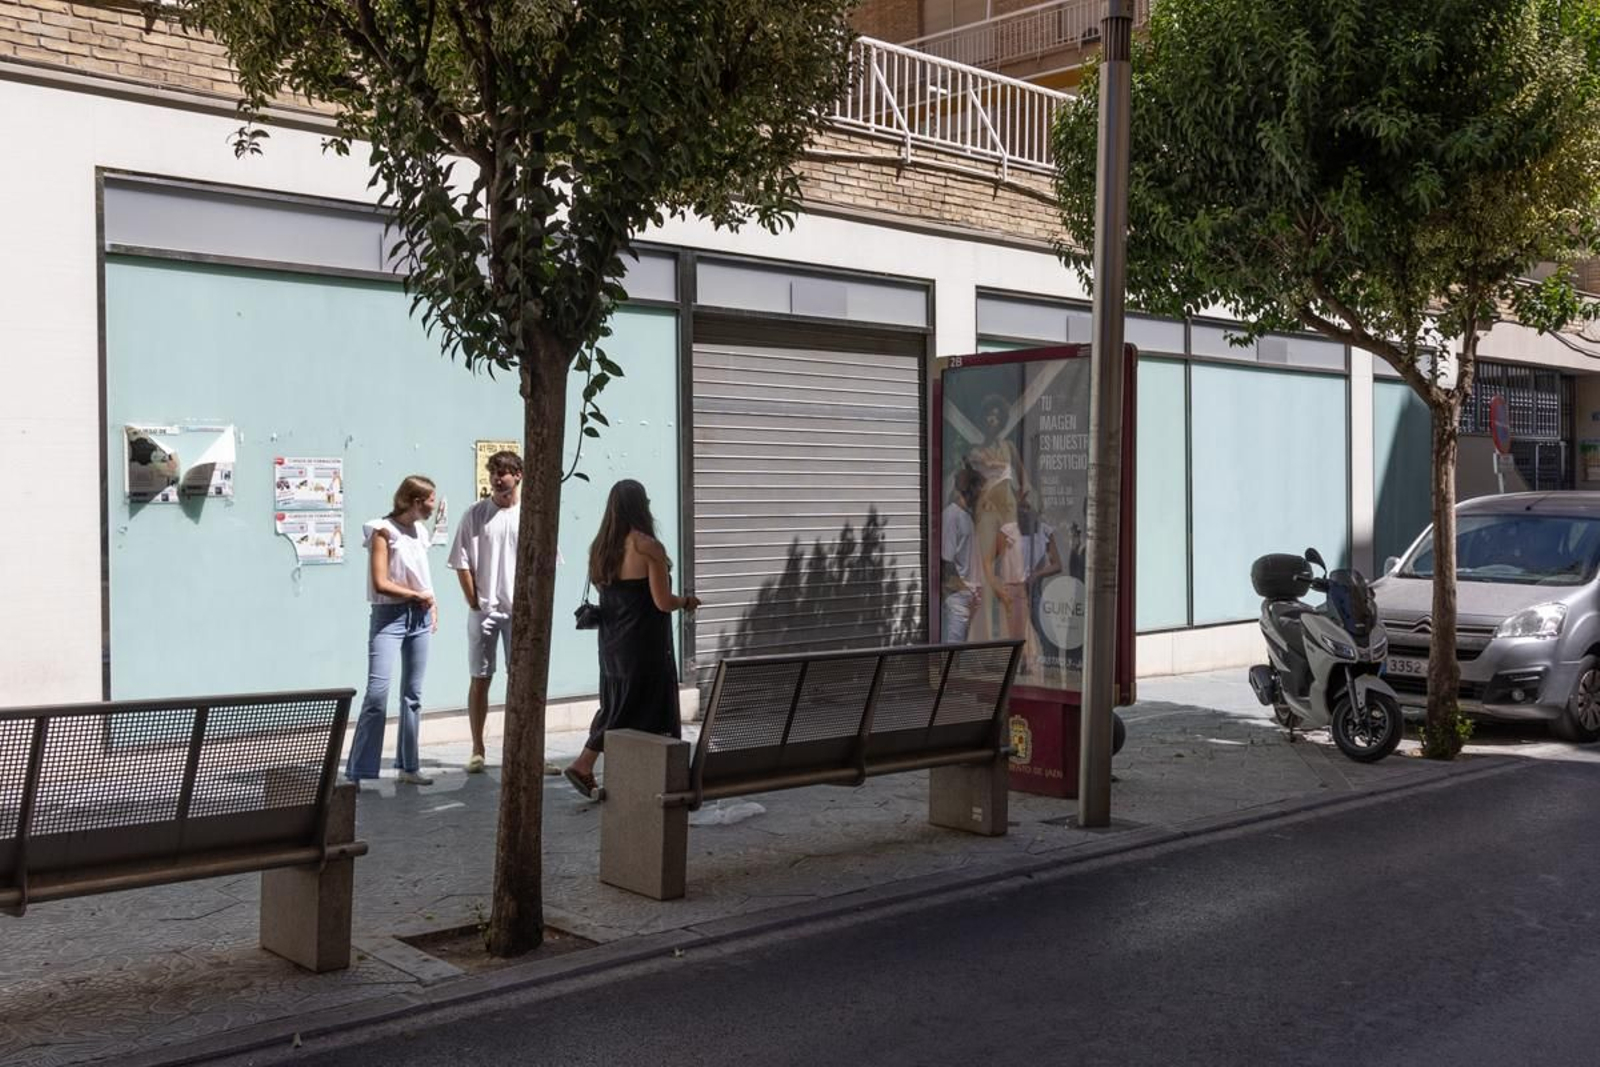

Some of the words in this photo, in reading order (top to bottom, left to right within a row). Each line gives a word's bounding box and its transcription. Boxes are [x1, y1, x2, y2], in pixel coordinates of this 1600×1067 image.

[1041, 395, 1053, 411] TU
[1039, 414, 1077, 430] IMAGEN
[1040, 434, 1050, 450] ES
[1039, 453, 1088, 470] PRESTIGIO
[1390, 659, 1422, 673] 3352
